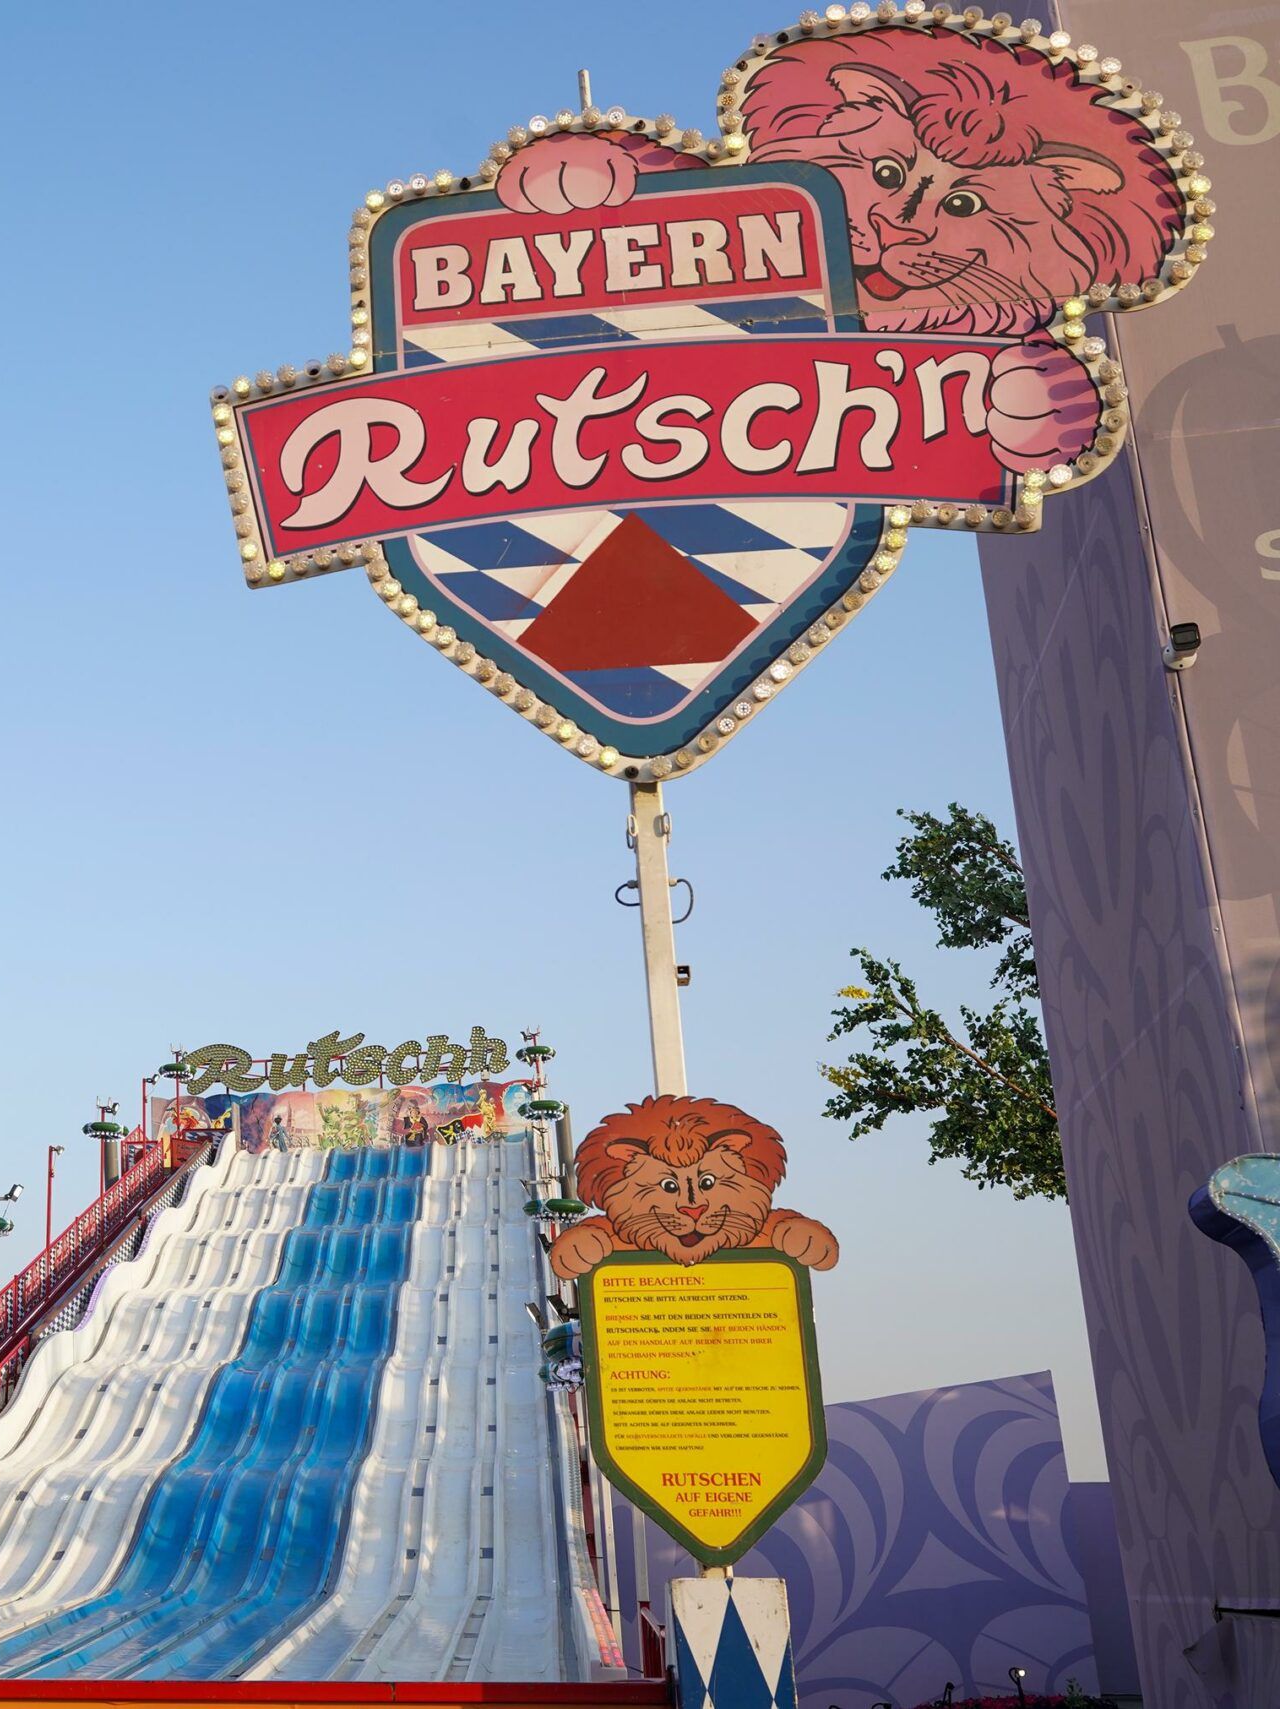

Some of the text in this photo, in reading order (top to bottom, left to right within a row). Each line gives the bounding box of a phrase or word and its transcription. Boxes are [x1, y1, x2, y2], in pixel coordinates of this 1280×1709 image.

[410, 211, 804, 312] BAYERN
[279, 349, 992, 530] Rutsch'n
[602, 1276, 704, 1287] BITTE BEACHTEN:
[610, 1370, 670, 1380] ACHTUNG:
[662, 1472, 762, 1487] RUTSCHEN
[675, 1492, 753, 1503] AUF EIGENE
[688, 1508, 742, 1518] GEFAHR!!!
